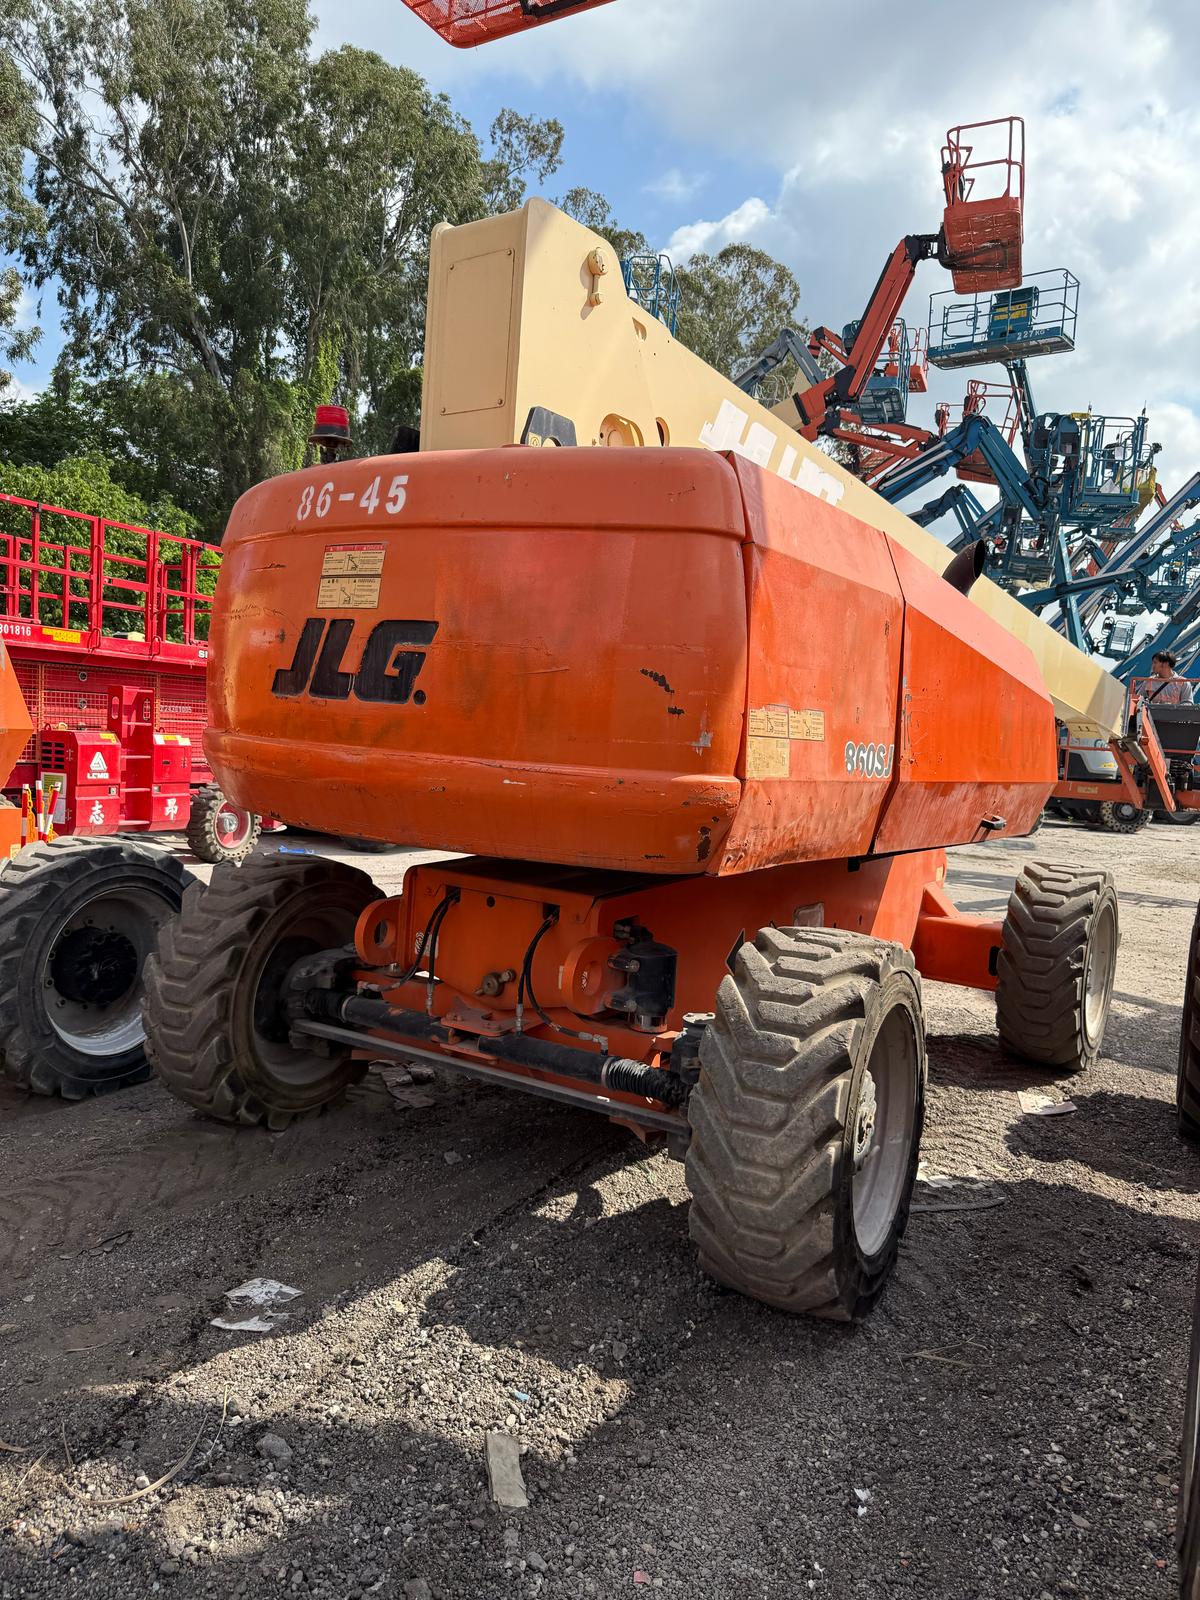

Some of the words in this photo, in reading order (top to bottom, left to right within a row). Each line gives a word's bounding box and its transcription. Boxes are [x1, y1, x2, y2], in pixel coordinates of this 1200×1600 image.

[297, 475, 409, 521] 86-45
[89, 800, 105, 825] 志
[165, 798, 179, 820] 昂
